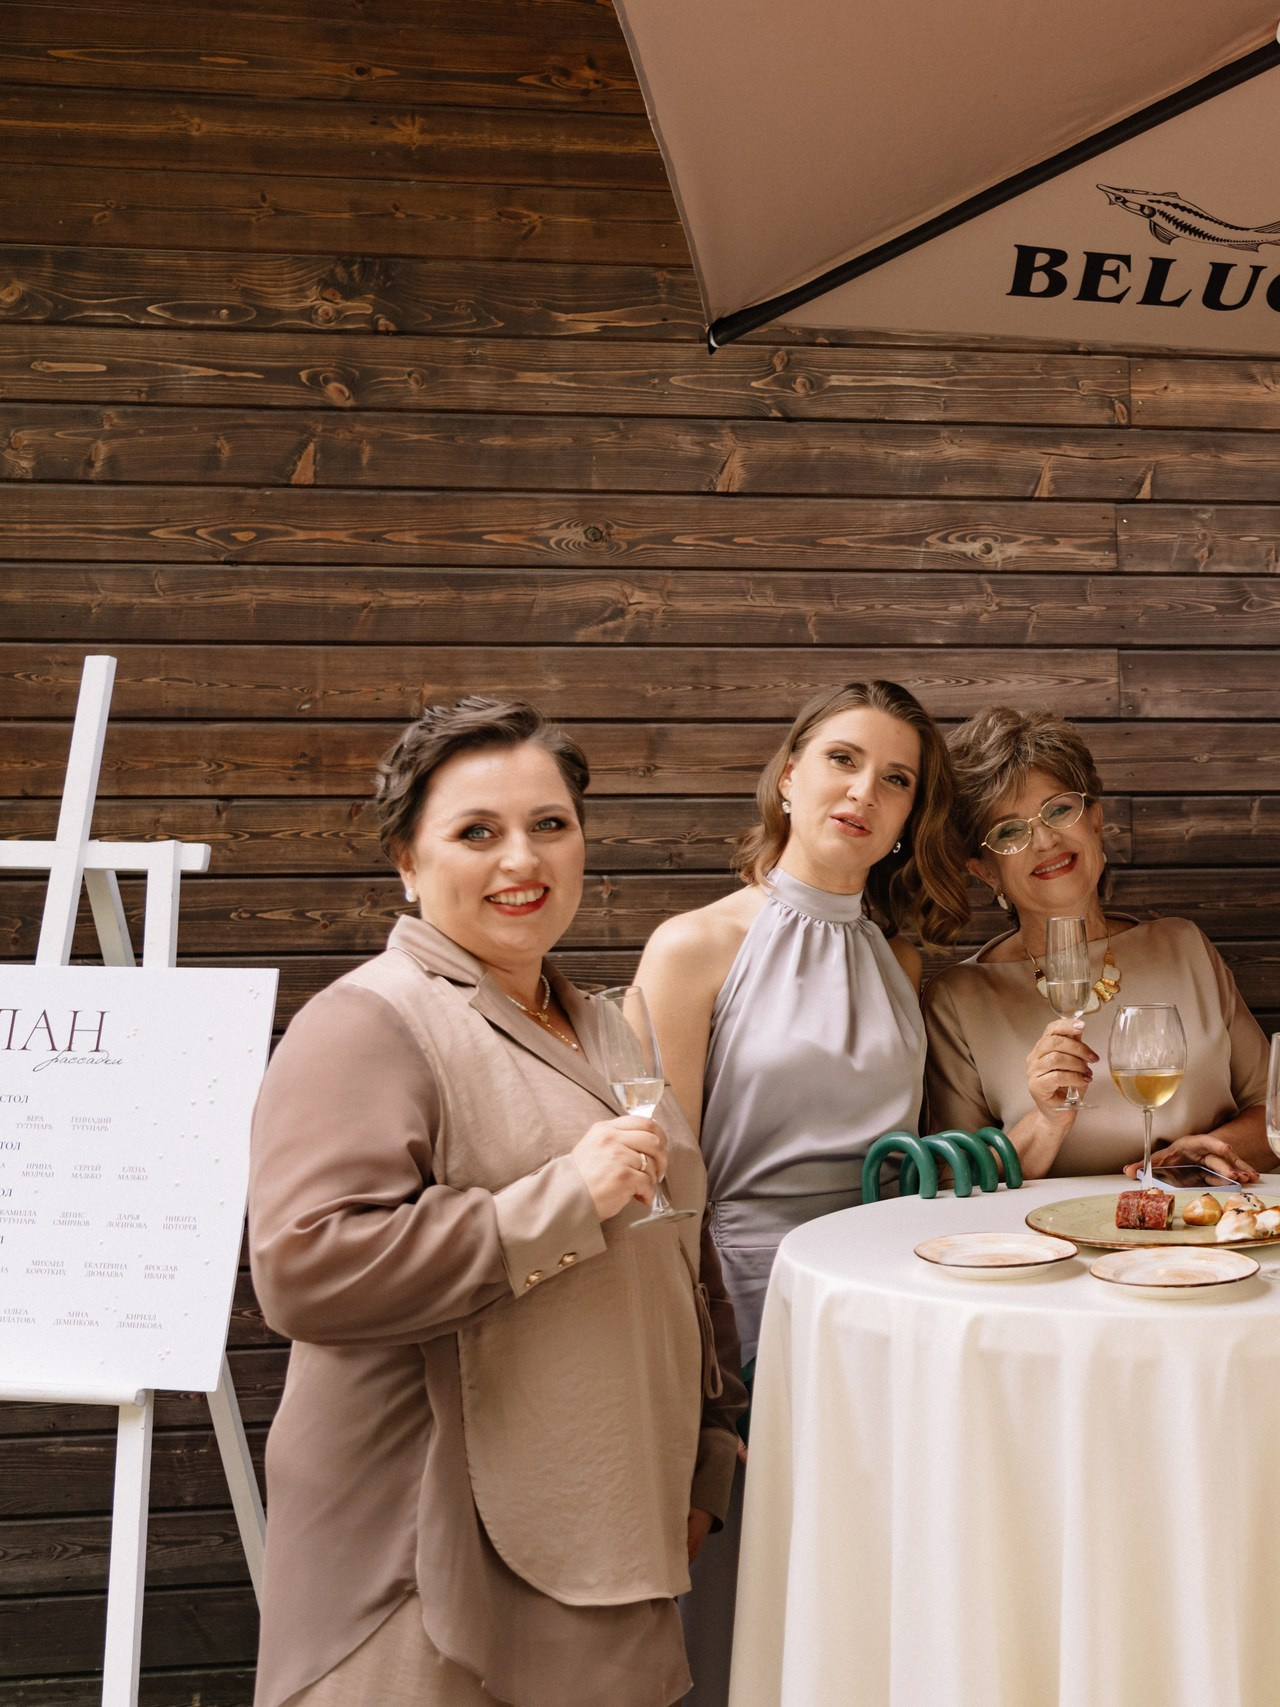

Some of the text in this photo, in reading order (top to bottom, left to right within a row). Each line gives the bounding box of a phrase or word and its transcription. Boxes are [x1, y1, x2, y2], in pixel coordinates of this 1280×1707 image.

[0, 1008, 111, 1053] ЛАН
[0, 1094, 29, 1104] СТОЛ
[71, 1116, 112, 1125] ГЕННАДИЙ
[0, 1141, 22, 1151] ТОЛ
[74, 1164, 102, 1173] СЕРГЕЙ
[122, 1166, 147, 1174] ЕЛЕНА
[59, 1211, 87, 1219] ДЕНИС
[116, 1213, 141, 1221] ДАРЬЯ
[52, 1219, 91, 1227] СМИРНОВ
[31, 1260, 65, 1268] МИХАИЛ
[84, 1262, 129, 1270] ЕКАТЕРИНА
[144, 1264, 179, 1273] ЯРОСЛАВ
[144, 1272, 176, 1280] ИВАНОВ
[4, 1308, 28, 1316] ОЛЬГА
[0, 1316, 36, 1325] ИЛАТОВА
[125, 1313, 157, 1321] КИРИЛЛ
